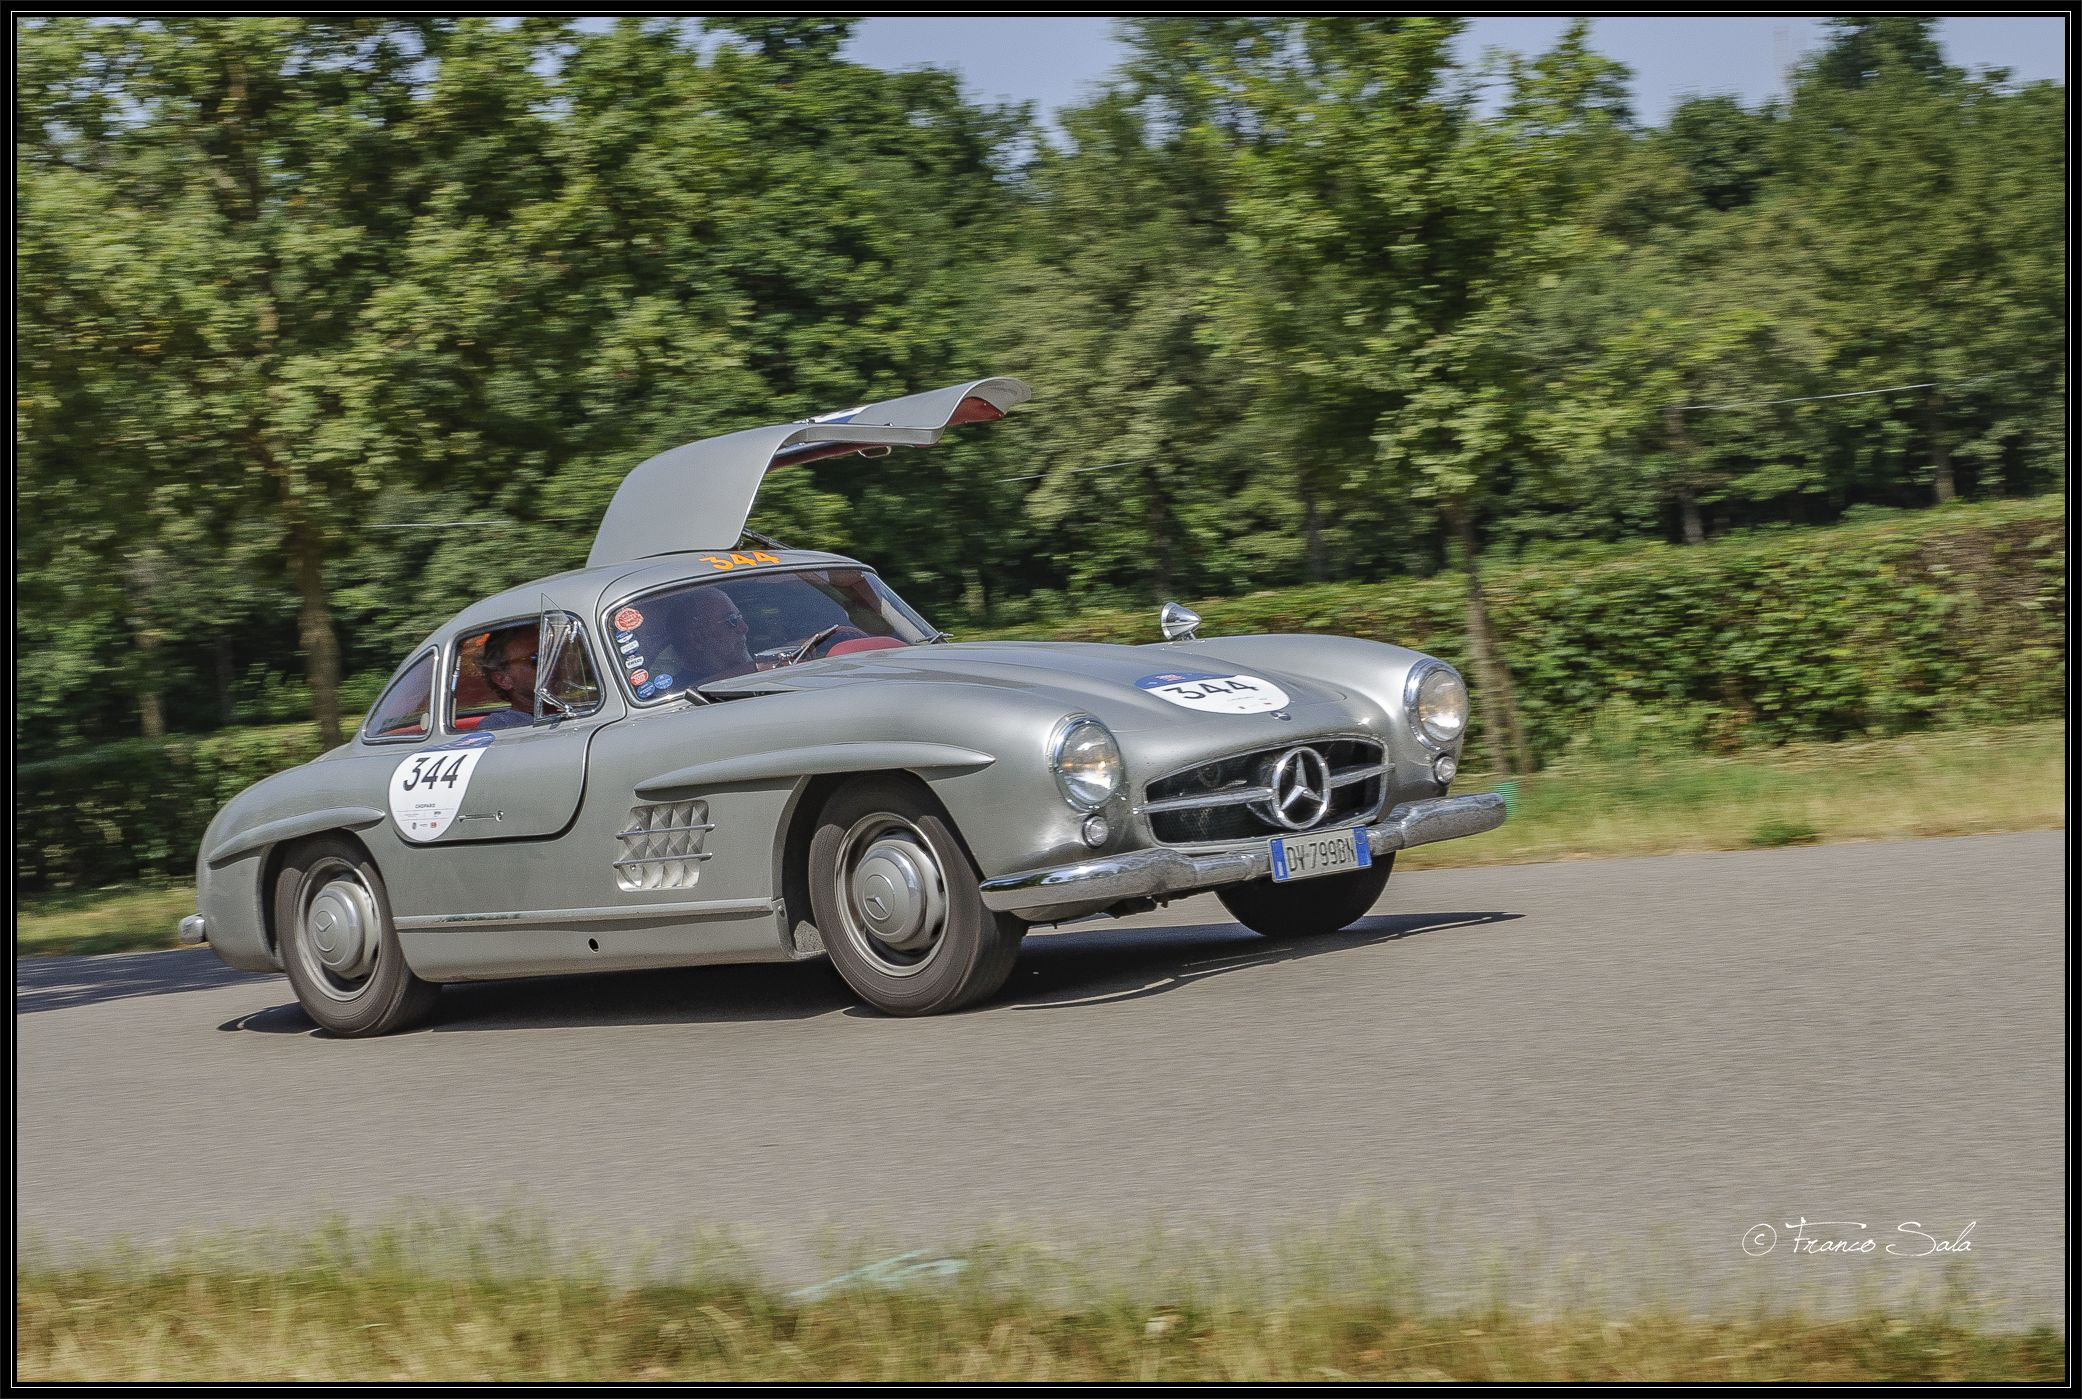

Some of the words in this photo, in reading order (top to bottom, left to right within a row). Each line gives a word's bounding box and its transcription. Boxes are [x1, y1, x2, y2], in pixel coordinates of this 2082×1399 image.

[699, 551, 781, 571] 344
[1162, 680, 1259, 700] 344
[403, 754, 468, 791] 344
